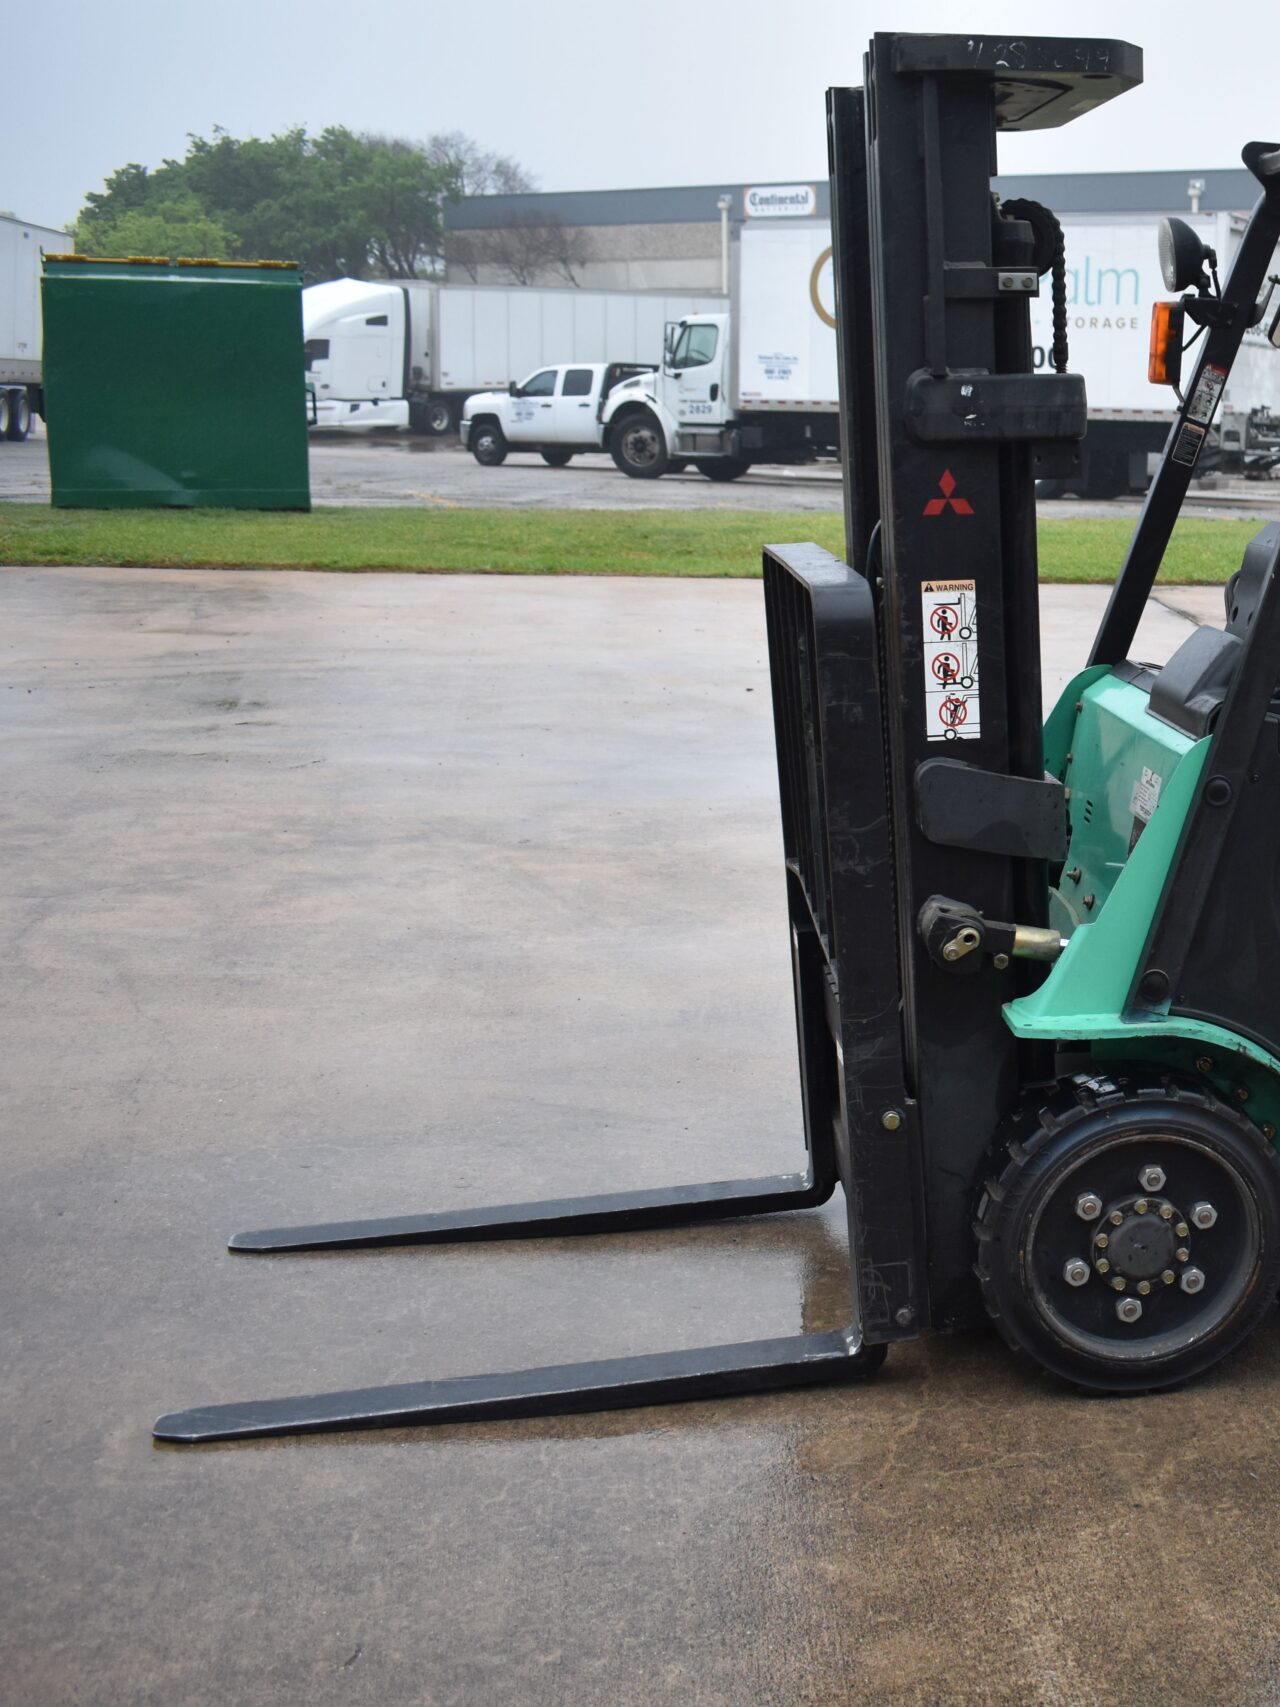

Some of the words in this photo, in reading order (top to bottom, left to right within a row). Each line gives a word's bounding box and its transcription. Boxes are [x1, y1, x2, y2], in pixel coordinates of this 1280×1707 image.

[749, 191, 809, 206] Continental
[1040, 256, 1139, 306] alm
[1052, 317, 1139, 329] TORAGE
[936, 583, 974, 592] WARNING
